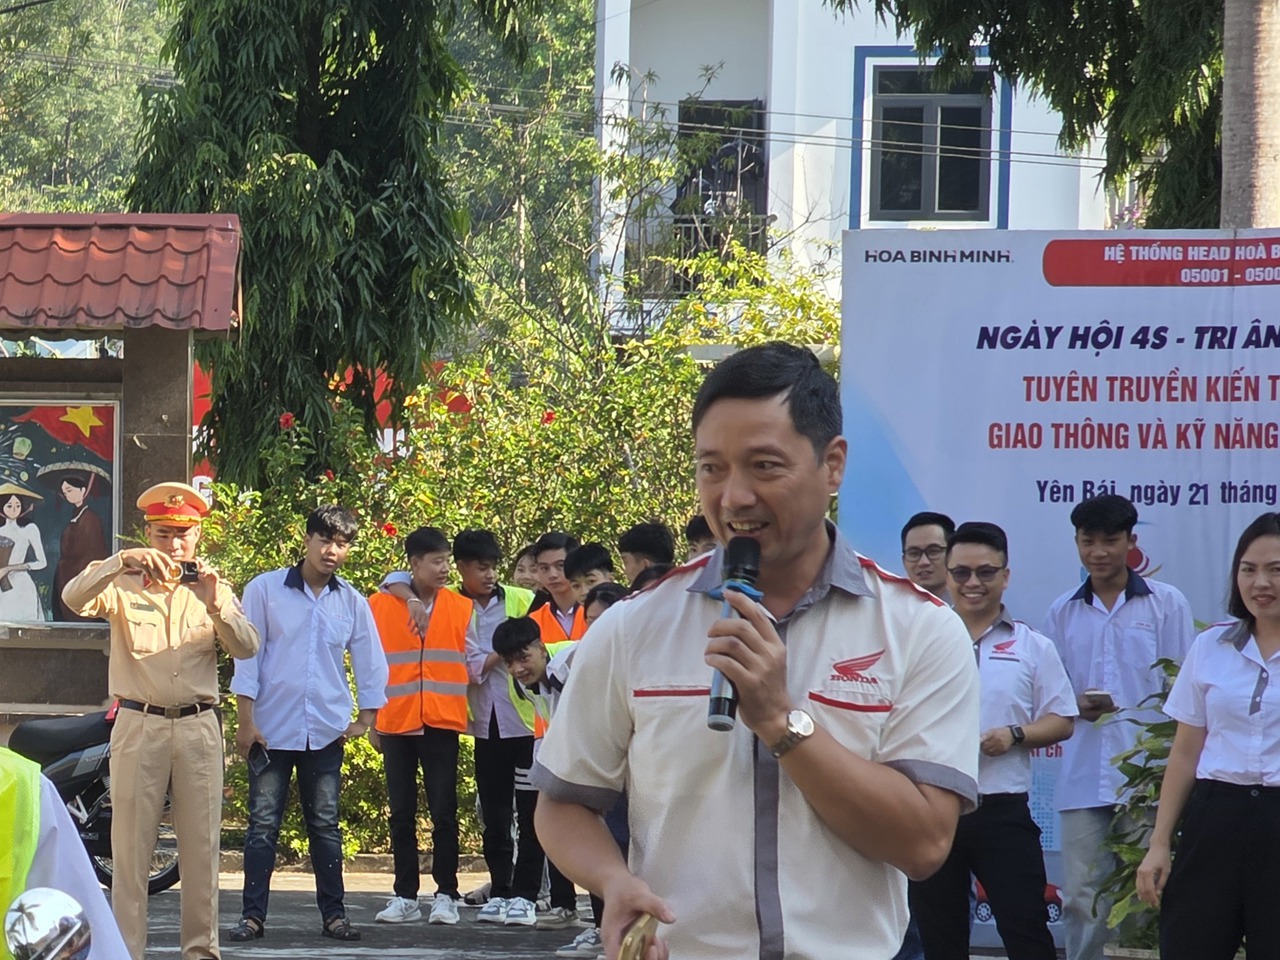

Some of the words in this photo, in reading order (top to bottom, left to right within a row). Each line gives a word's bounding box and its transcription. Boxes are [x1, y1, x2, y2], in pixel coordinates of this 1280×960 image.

[959, 250, 1011, 263] MINH
[1104, 244, 1126, 264] HỆ
[1130, 241, 1183, 261] THỐNG
[1188, 246, 1231, 261] HEAD
[1234, 242, 1267, 260] HOÀ
[1181, 268, 1229, 283] 05001
[976, 319, 1062, 350] NGÀY
[1068, 320, 1124, 357] HỘI
[1131, 326, 1169, 350] 4S
[1193, 326, 1238, 350] TRI
[1241, 318, 1280, 349] ÂN
[1023, 370, 1098, 402] TUYÊN
[1105, 366, 1197, 402] TRUYỀN
[1205, 366, 1260, 402] KIẾN
[988, 422, 1043, 449] GIAO
[1052, 417, 1129, 449] THÔNG
[1138, 417, 1168, 449] VÀ
[1176, 417, 1207, 450] KỸ
[1214, 417, 1279, 450] NĂNG
[1036, 479, 1075, 503] Yên
[1130, 480, 1181, 505] ngày
[1188, 483, 1209, 505] 21
[1220, 480, 1278, 505] tháng
